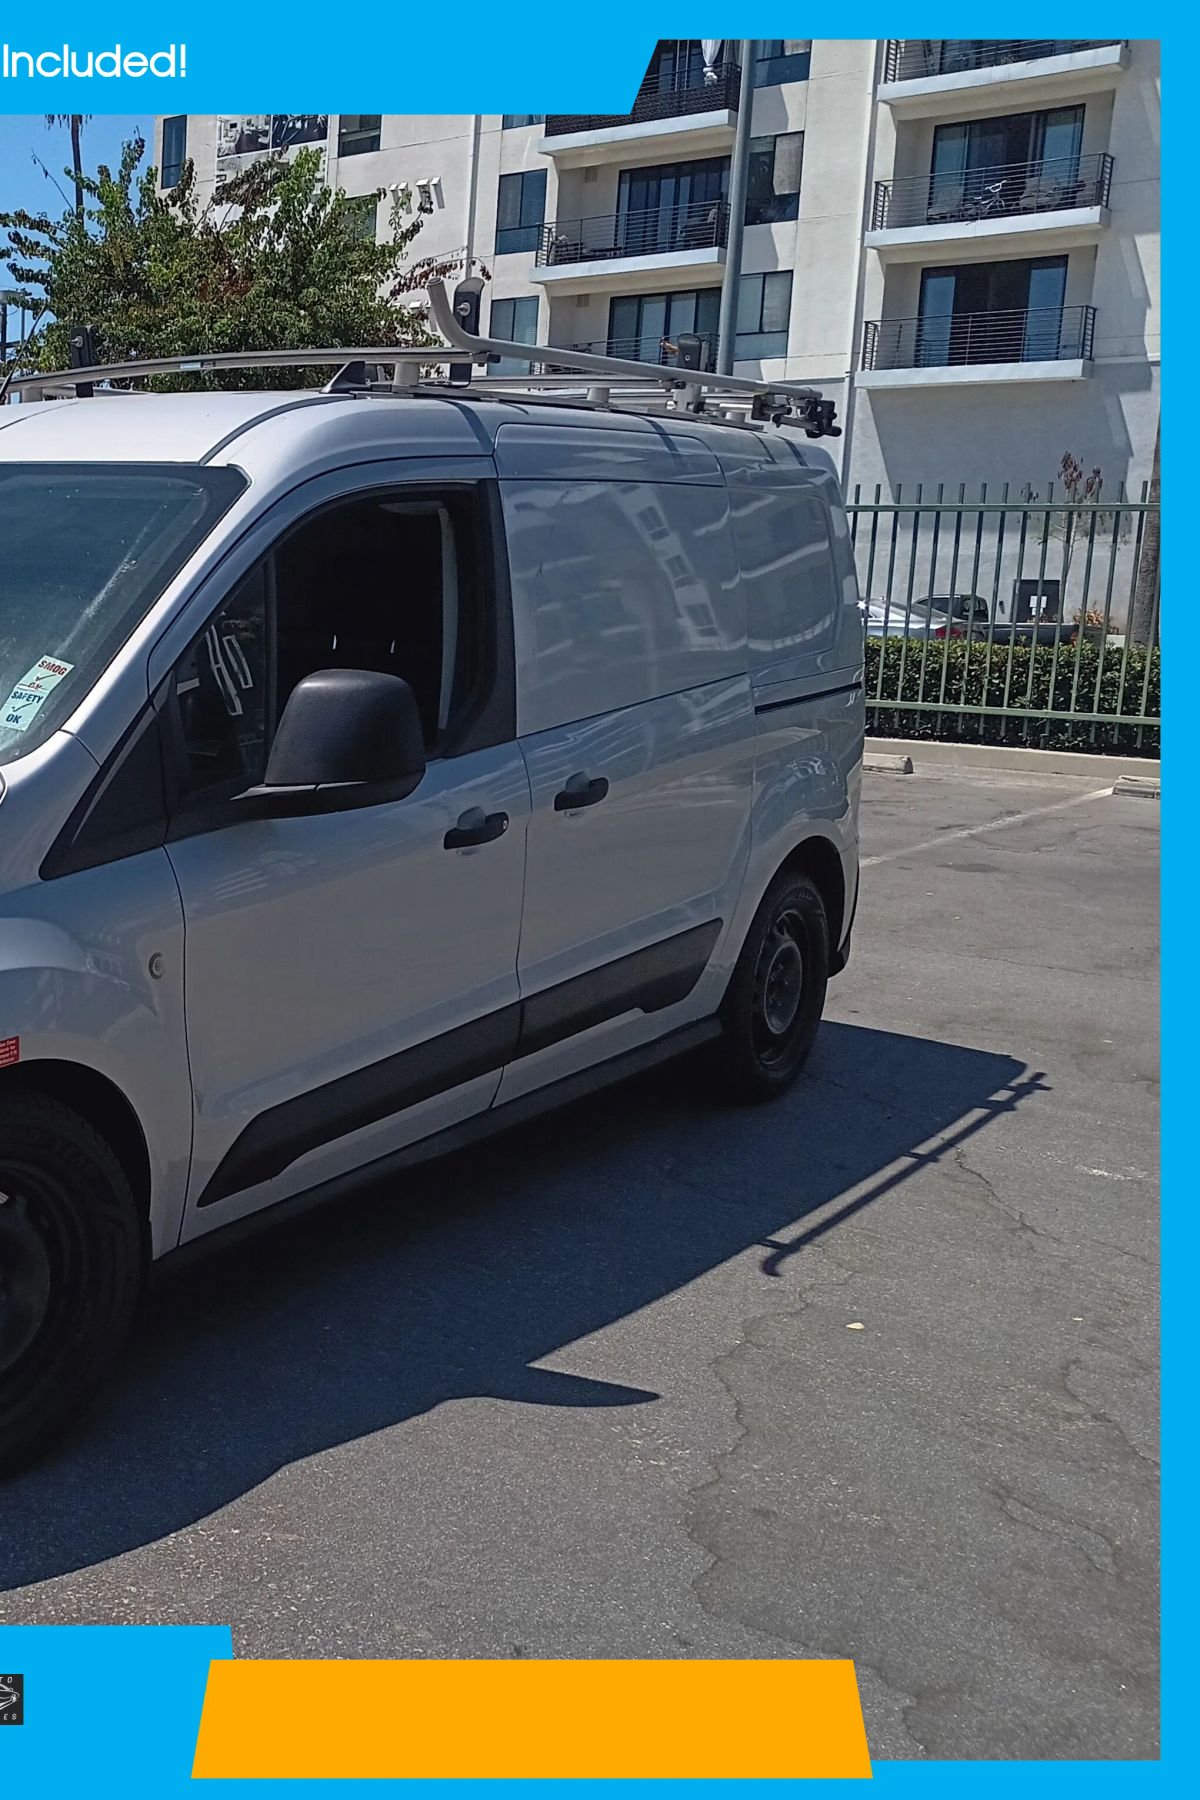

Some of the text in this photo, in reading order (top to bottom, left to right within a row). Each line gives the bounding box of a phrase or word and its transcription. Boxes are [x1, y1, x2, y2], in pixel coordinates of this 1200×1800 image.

[38, 660, 67, 675] SMOG
[12, 692, 44, 703] SAFETY
[6, 714, 22, 724] OK
